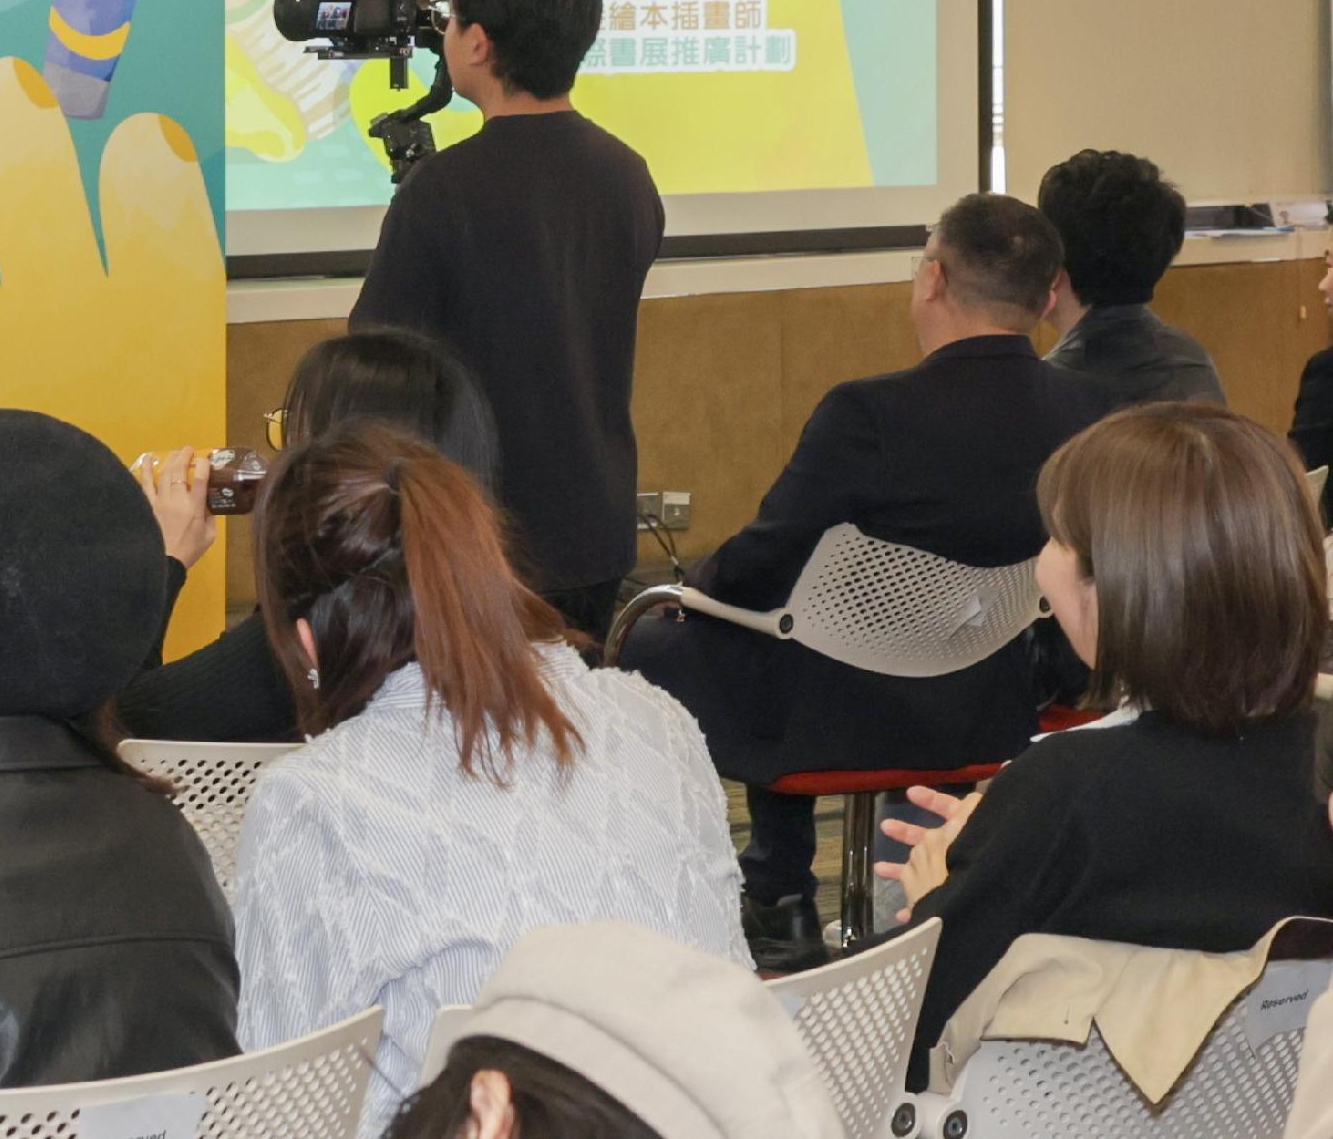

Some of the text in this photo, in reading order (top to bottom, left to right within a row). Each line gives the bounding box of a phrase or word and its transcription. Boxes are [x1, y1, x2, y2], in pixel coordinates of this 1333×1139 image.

[600, 0, 762, 31] 繪本插畫師
